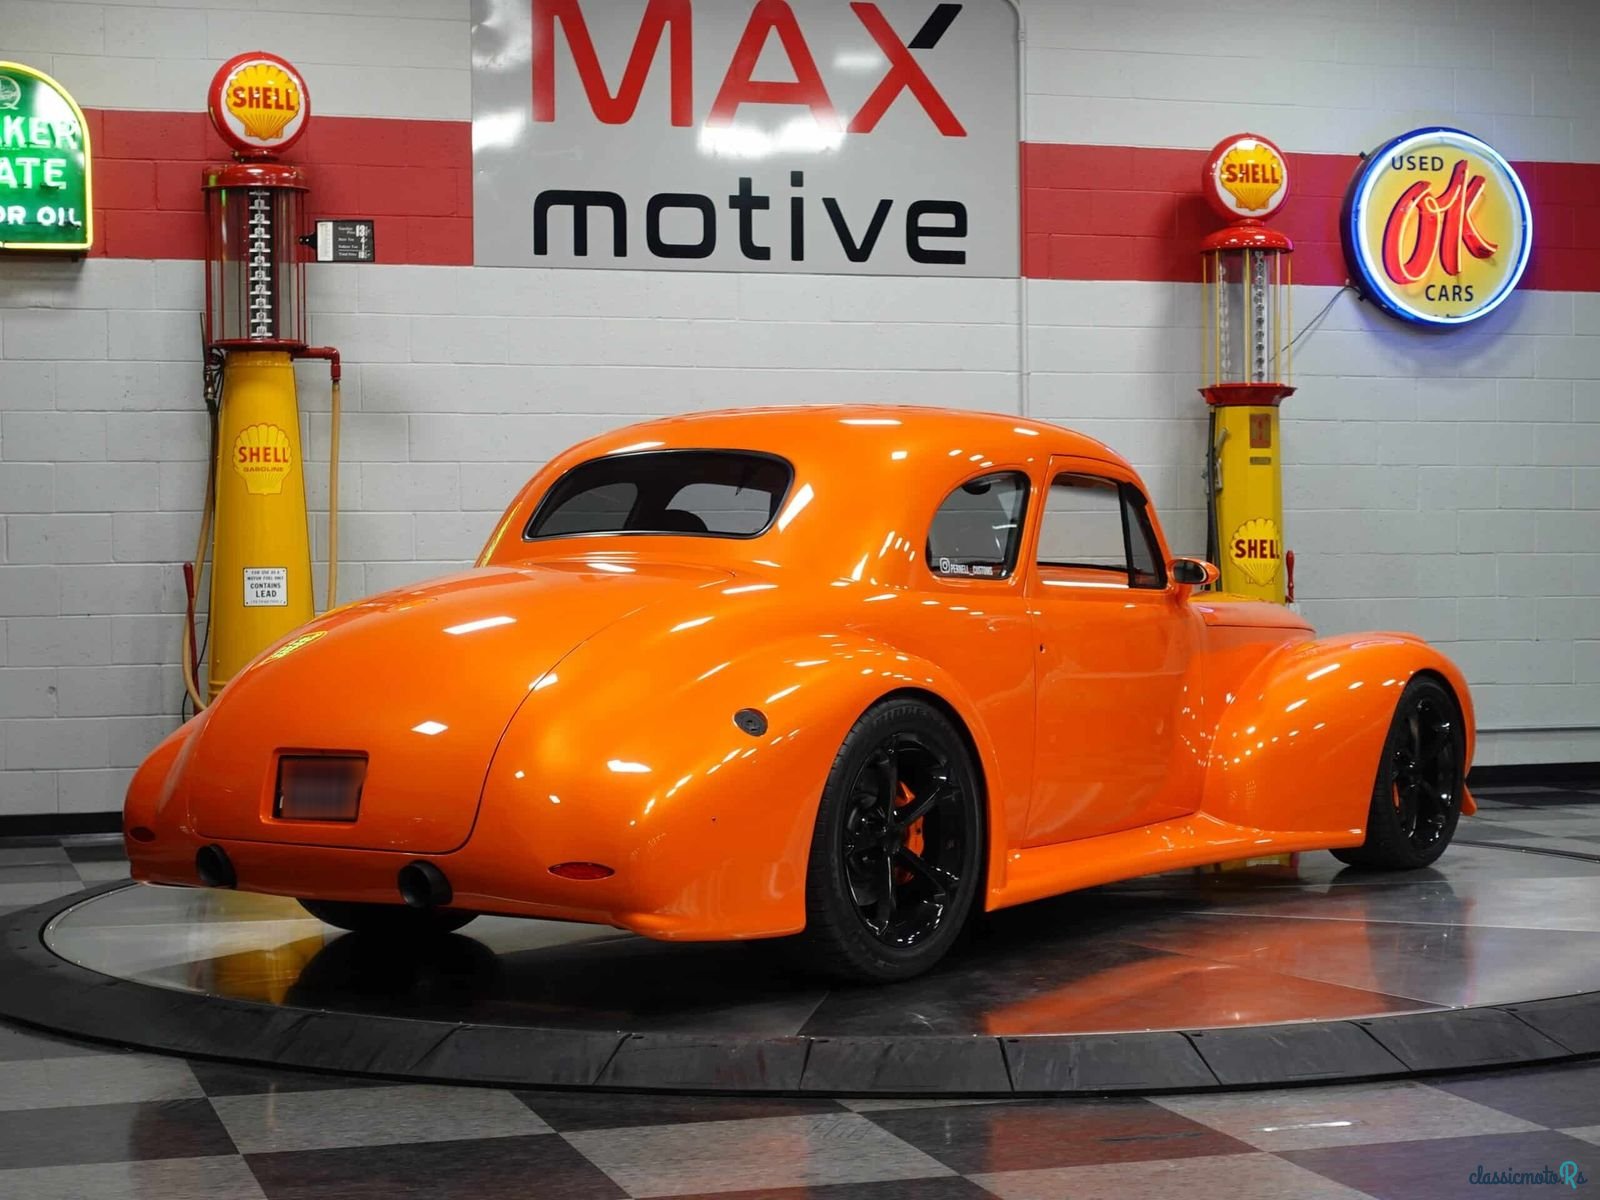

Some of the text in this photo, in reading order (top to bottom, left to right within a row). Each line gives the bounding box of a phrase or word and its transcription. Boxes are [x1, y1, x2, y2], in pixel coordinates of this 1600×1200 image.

[532, 0, 967, 137] MAX
[231, 85, 296, 113] SHELL
[0, 114, 78, 149] KER
[1225, 162, 1280, 185] SHELL
[1391, 155, 1444, 172] USED
[36, 205, 82, 228] OIL
[533, 171, 967, 265] motive
[1382, 159, 1499, 285] OK
[1425, 284, 1475, 302] CARS
[238, 446, 289, 463] SHELL
[255, 590, 277, 598] LEAD
